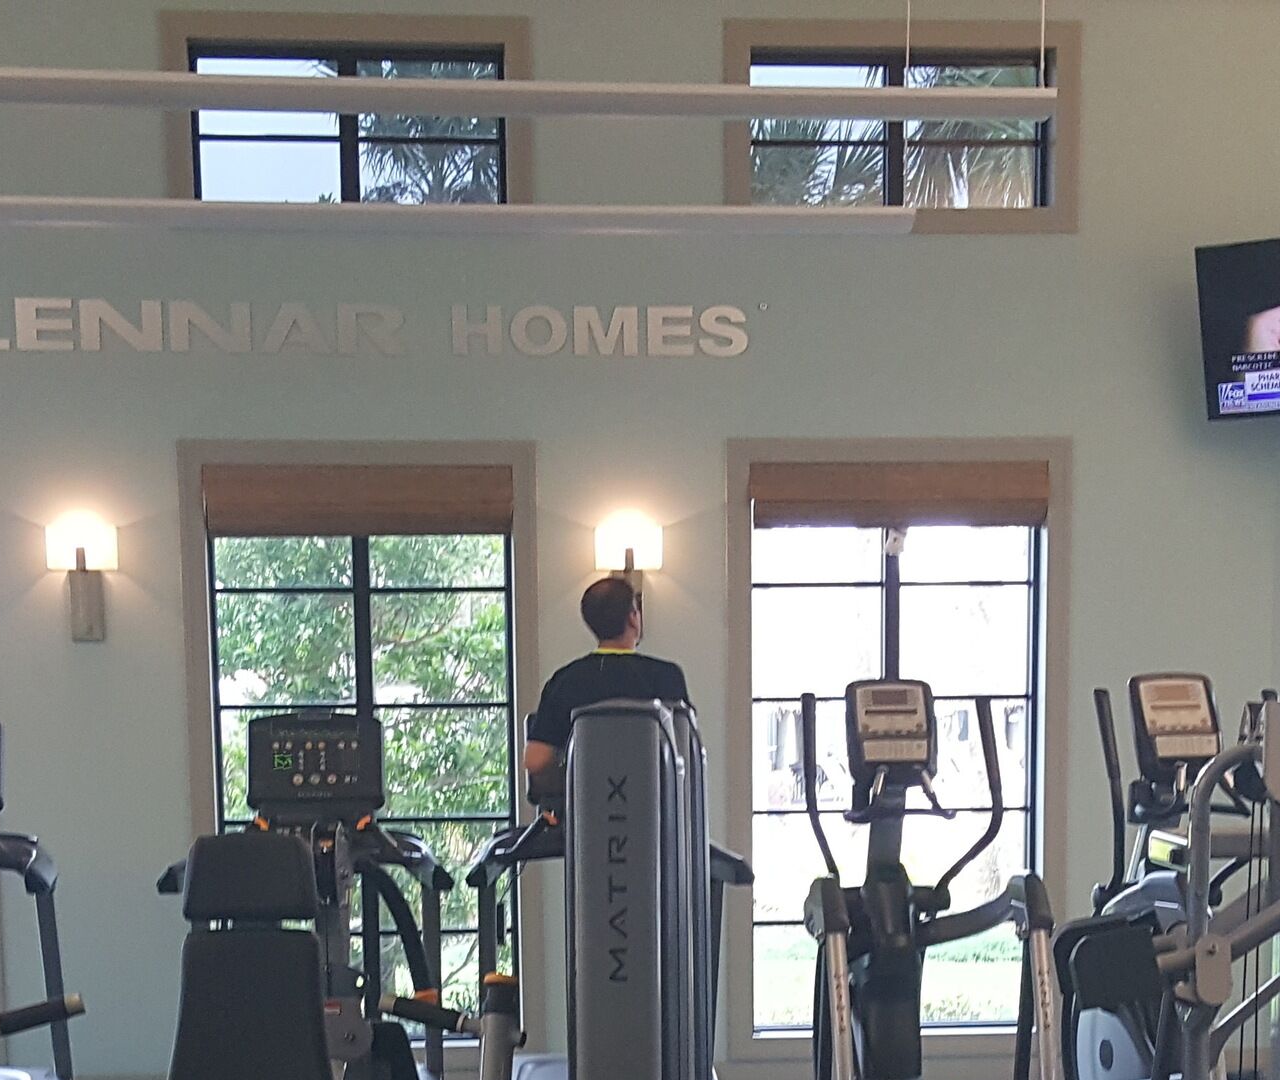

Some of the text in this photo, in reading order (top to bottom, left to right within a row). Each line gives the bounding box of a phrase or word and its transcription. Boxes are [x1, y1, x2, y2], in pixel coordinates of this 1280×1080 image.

[451, 303, 749, 358] HOMES
[1232, 353, 1277, 363] PRESCRIBE
[607, 775, 629, 983] MATRIX
